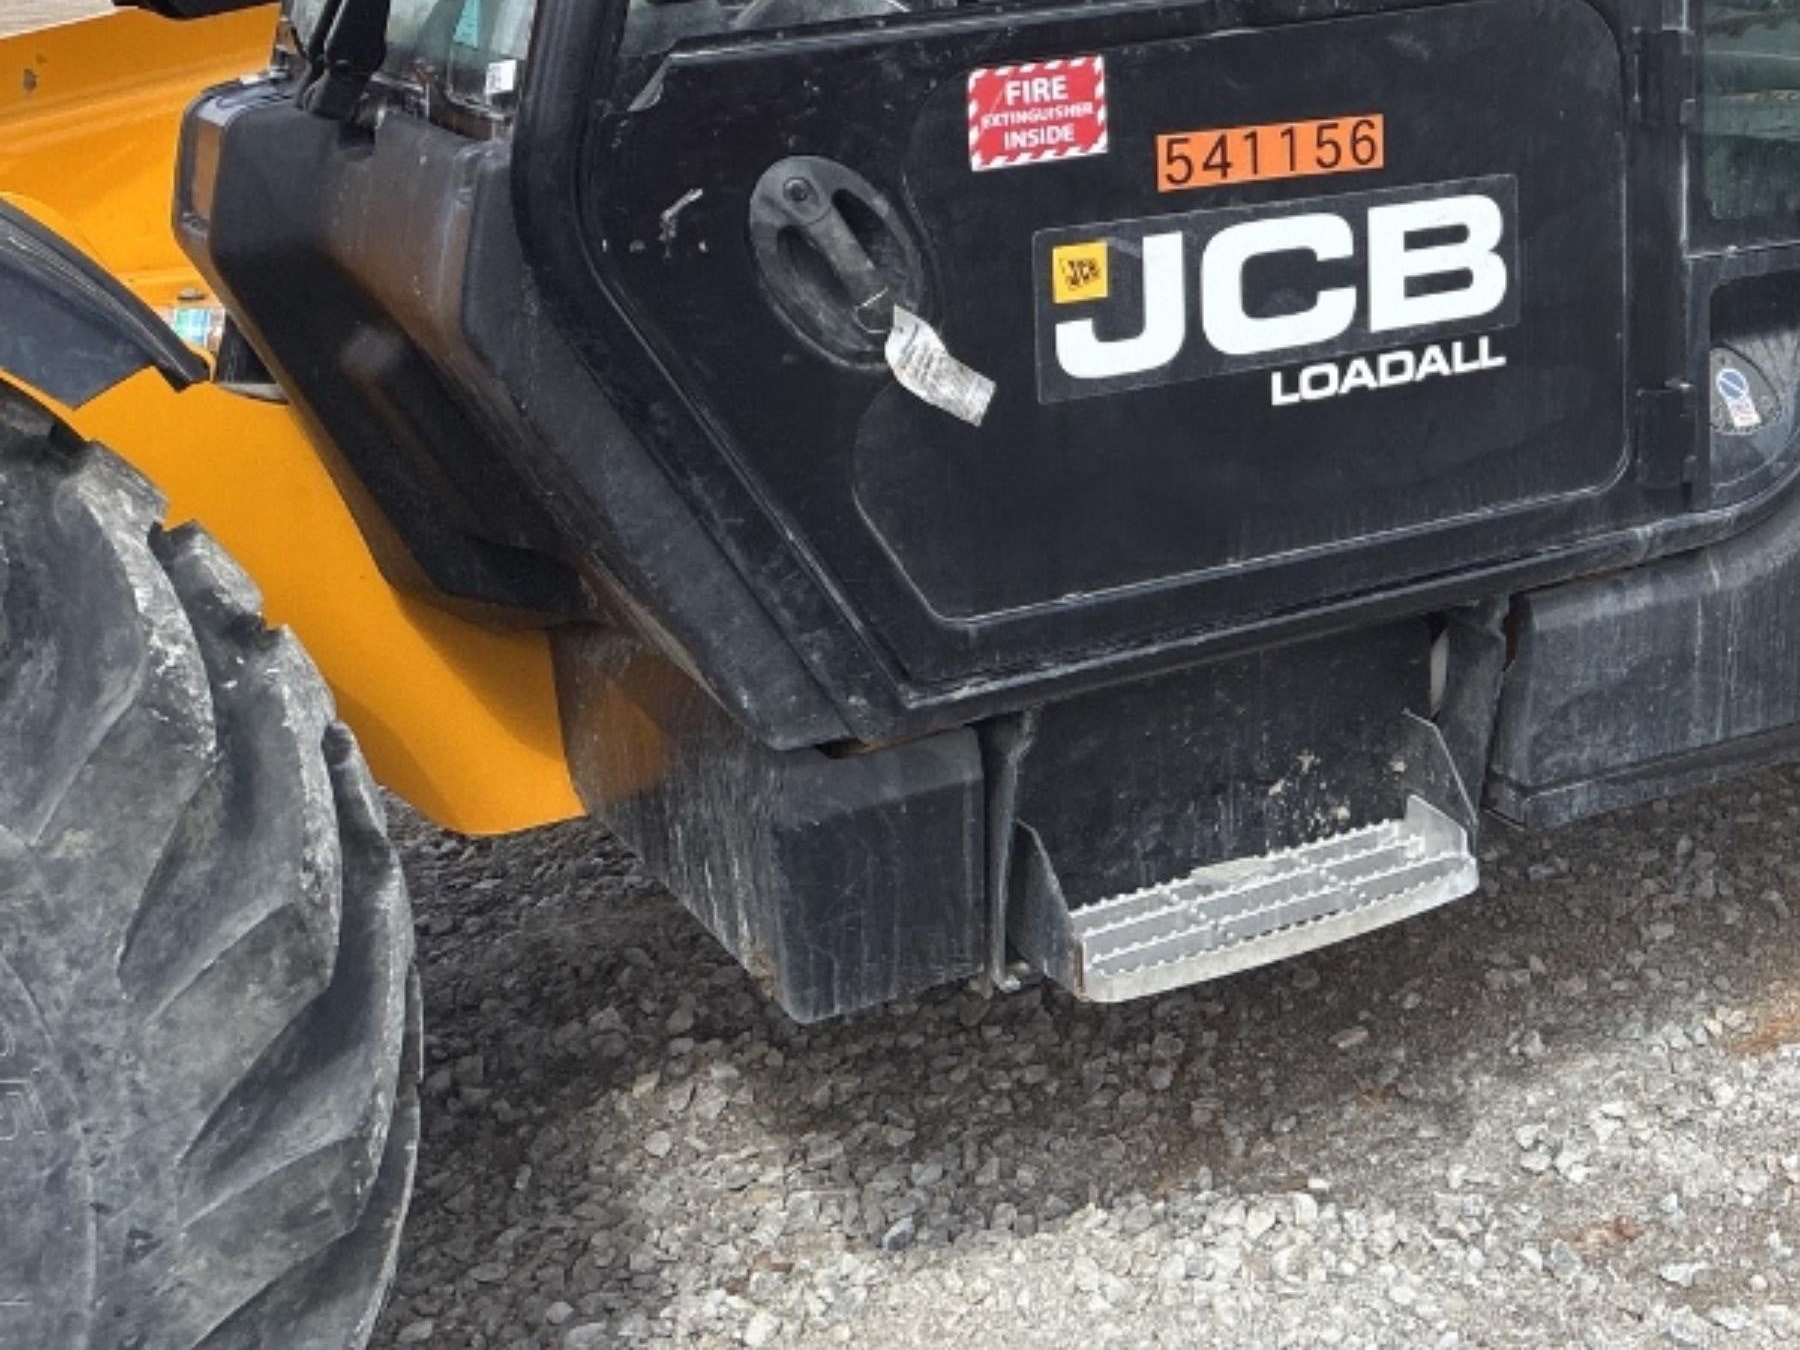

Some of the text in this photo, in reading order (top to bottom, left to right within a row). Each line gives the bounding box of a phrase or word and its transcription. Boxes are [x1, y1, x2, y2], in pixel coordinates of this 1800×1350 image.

[981, 101, 1095, 128] EXTINGUISHER
[1006, 76, 1068, 105] FIRE
[1004, 125, 1074, 150] INSIDE
[1164, 119, 1378, 186] 541156
[1053, 194, 1507, 381] JCB
[1270, 336, 1507, 407] LOADALL
